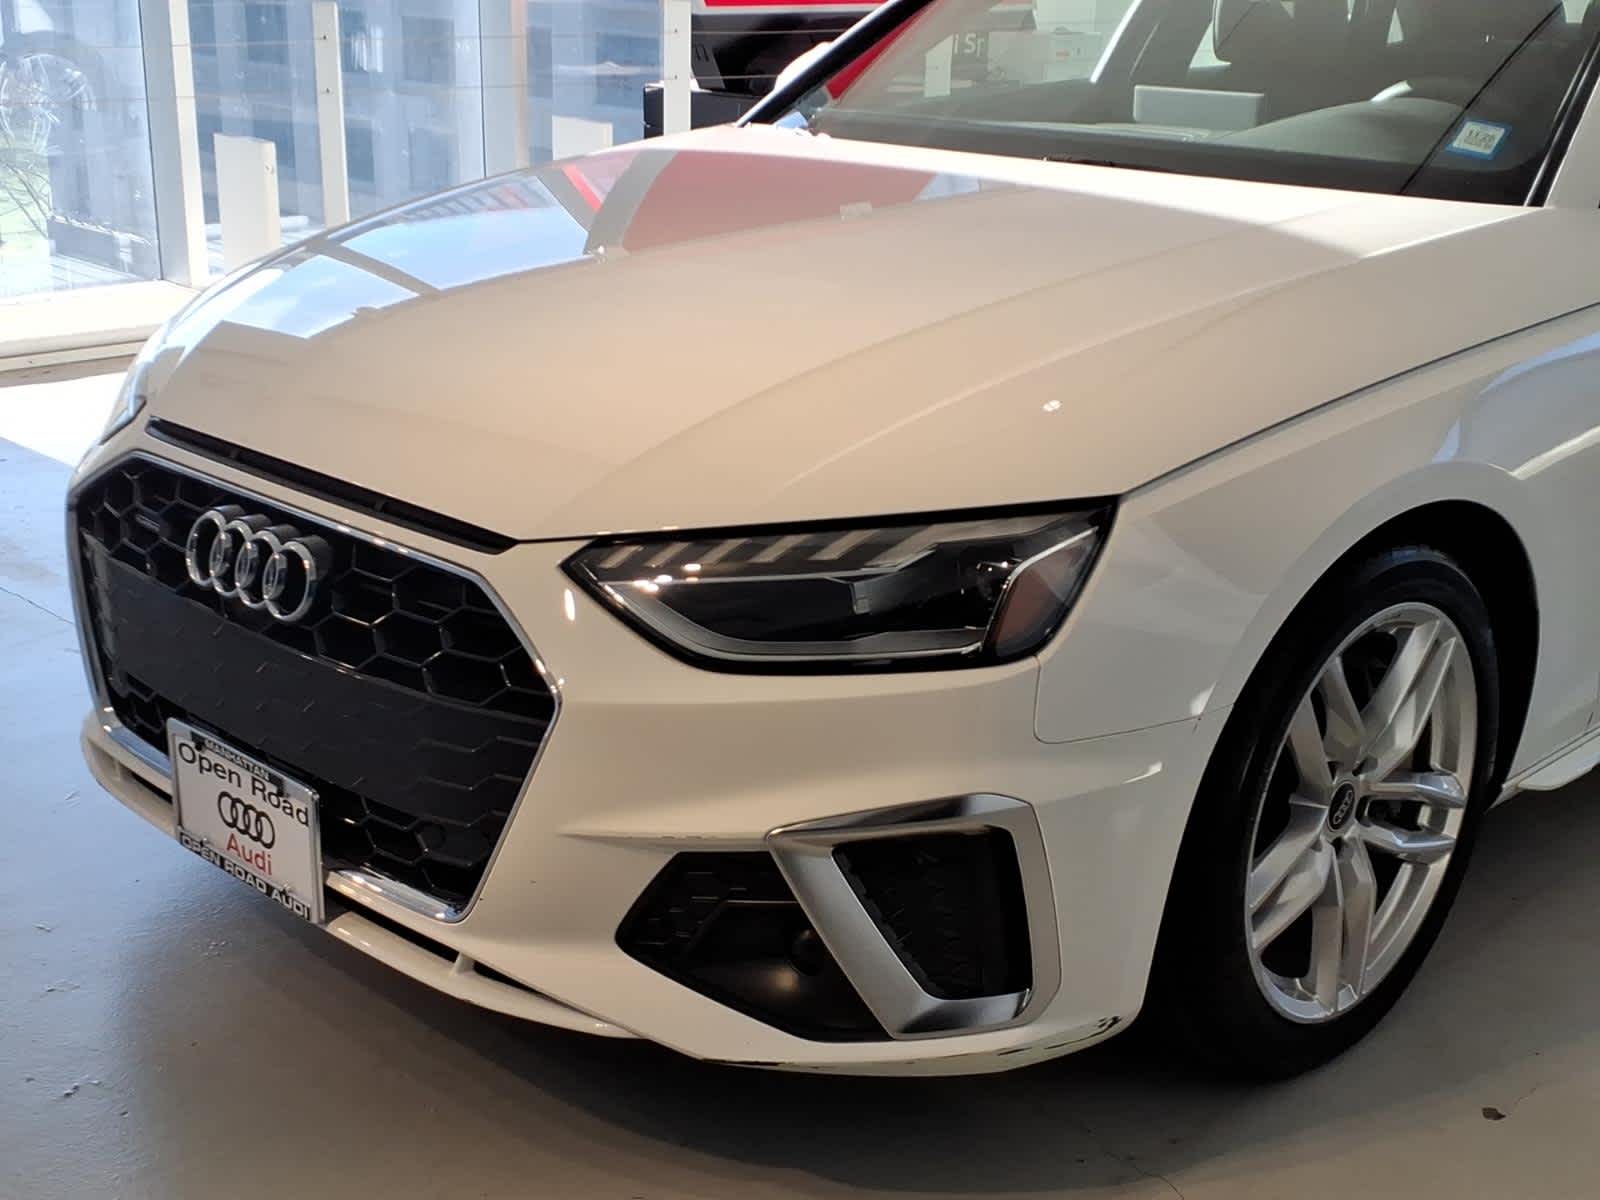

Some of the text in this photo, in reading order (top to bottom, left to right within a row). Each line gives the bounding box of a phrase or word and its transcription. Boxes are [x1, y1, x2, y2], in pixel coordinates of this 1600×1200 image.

[178, 742, 309, 827] Open Road
[203, 738, 271, 782] MANHATTAN
[182, 835, 311, 920] OPEN ROAD AUDI
[226, 833, 272, 876] Audi
